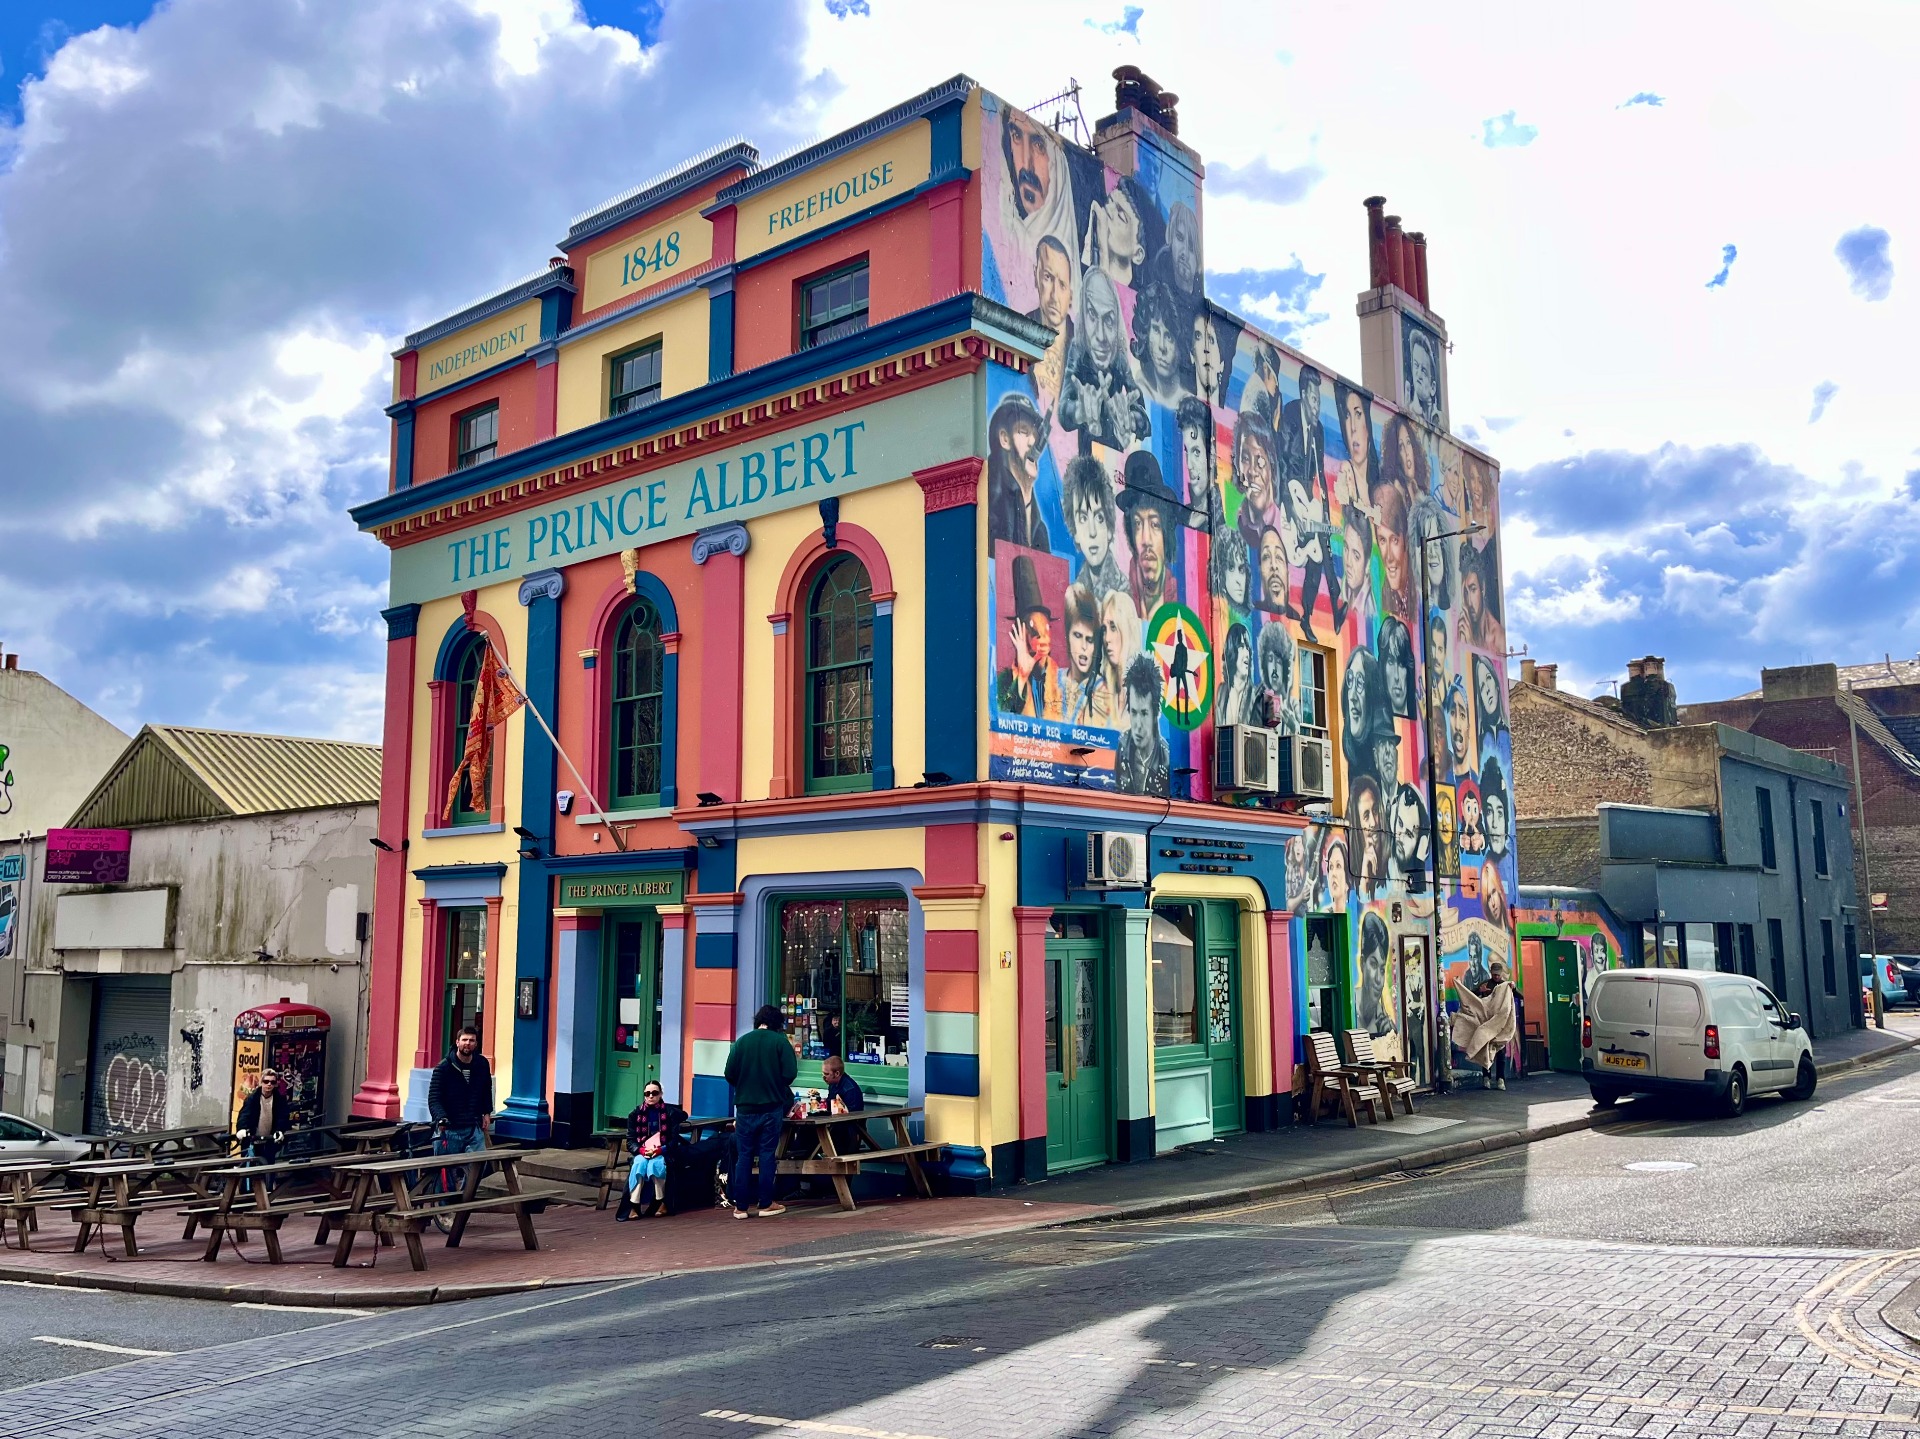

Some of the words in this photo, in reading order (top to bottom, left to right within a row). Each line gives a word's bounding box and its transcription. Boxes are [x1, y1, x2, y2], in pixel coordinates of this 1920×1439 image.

[767, 161, 894, 234] FREEHOUSE
[620, 231, 681, 287] 1848
[429, 323, 528, 381] INDEPENDENT
[448, 527, 512, 582] THE
[528, 479, 667, 562] PRINCE
[684, 420, 866, 519] ALBERT
[998, 718, 1028, 733] PAINTED
[1033, 723, 1042, 734] BY
[67, 840, 81, 850] for
[85, 841, 110, 850] sale
[567, 885, 588, 898] THE
[590, 883, 628, 897] PRINCE
[632, 881, 673, 895] ALBERT
[238, 1053, 260, 1067] good
